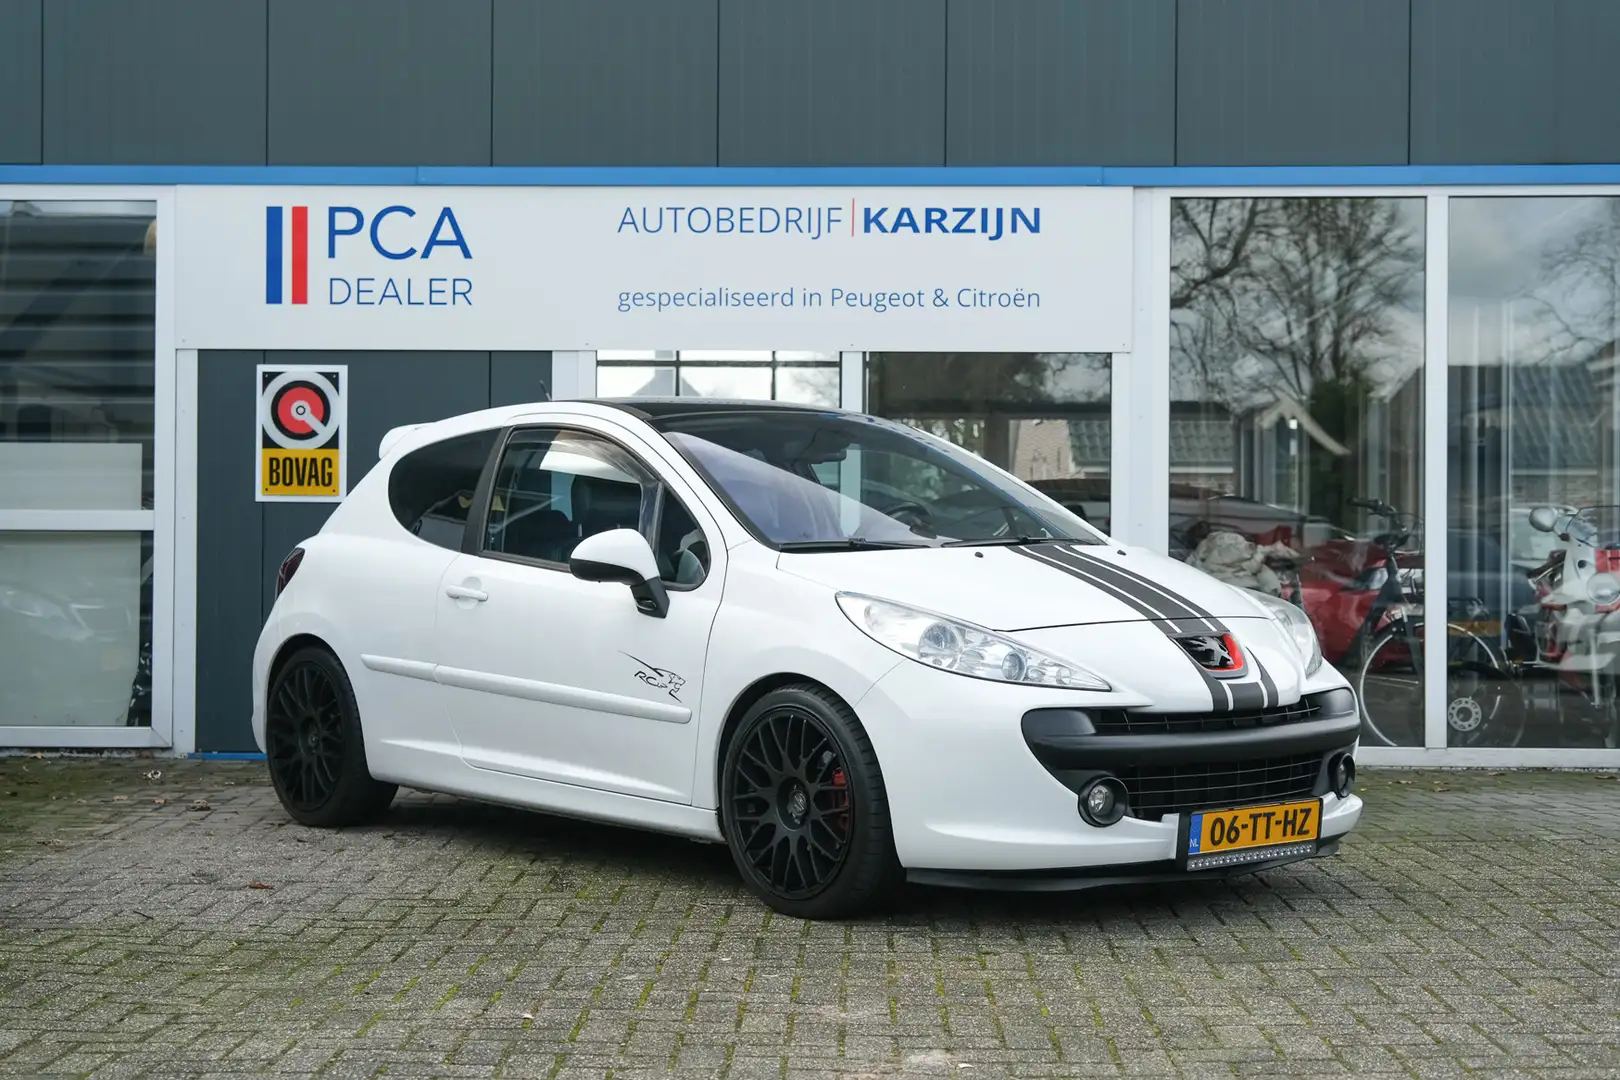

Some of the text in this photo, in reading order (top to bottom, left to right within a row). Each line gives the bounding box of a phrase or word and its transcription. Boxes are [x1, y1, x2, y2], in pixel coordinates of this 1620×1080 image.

[327, 205, 473, 260] PCA
[617, 206, 1041, 241] AUTOBEDRIJF KARZIJN
[329, 278, 473, 305] DEALER
[617, 287, 1041, 313] gespecialiseerd in Peugeot & Citroën
[268, 457, 333, 487] BOVAG
[1210, 808, 1312, 845] 06-TT-HZ
[1189, 838, 1199, 848] NL
